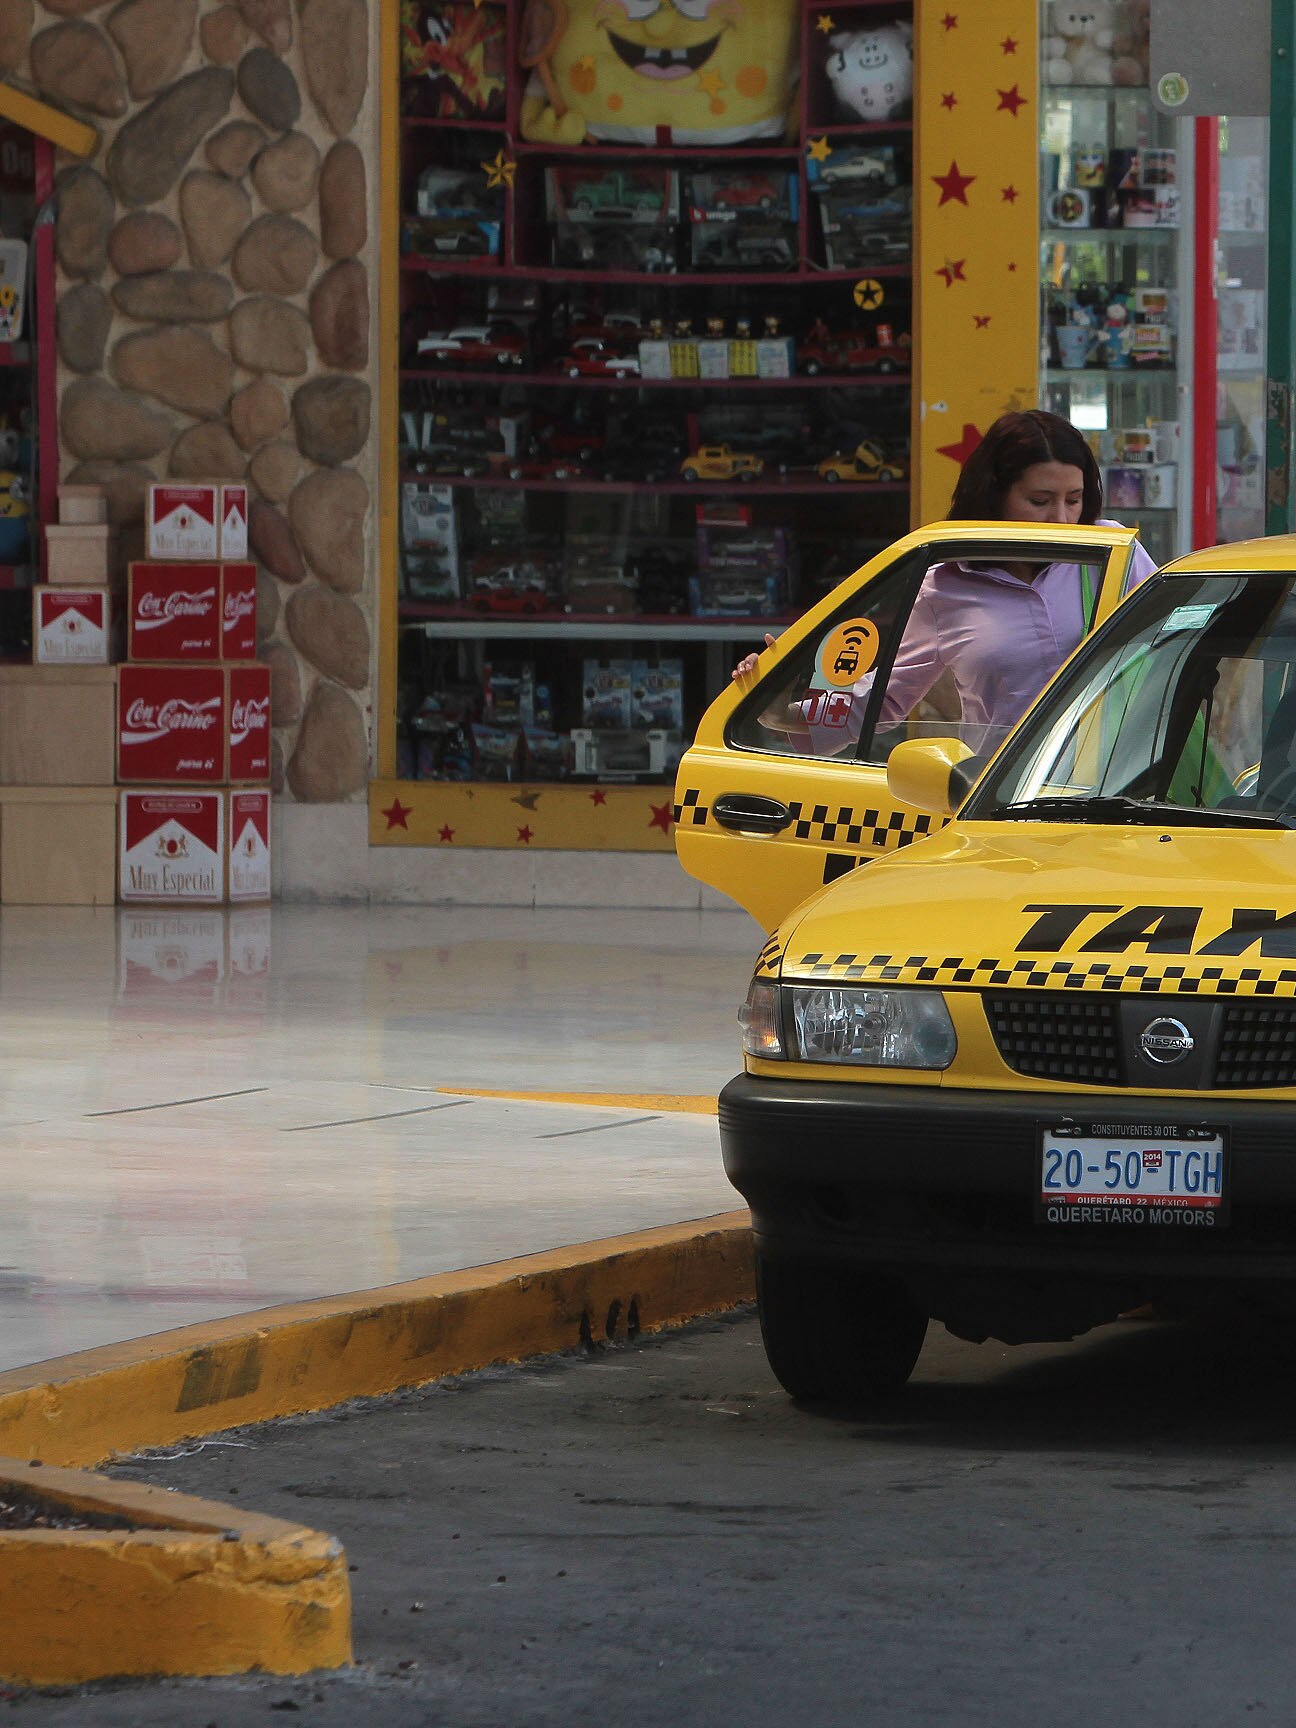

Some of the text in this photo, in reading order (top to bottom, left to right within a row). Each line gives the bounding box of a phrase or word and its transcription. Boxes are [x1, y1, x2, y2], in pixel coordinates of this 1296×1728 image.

[130, 864, 215, 896] Muy Especial
[1142, 1037, 1188, 1050] NISSAN
[1091, 1124, 1152, 1136] CONSTITUYENTES
[1153, 1126, 1162, 1136] 50
[1143, 1153, 1162, 1161] 2014
[1044, 1149, 1222, 1194] 20-50-TGH
[1047, 1206, 1215, 1226] QUERETARO MOTORS
